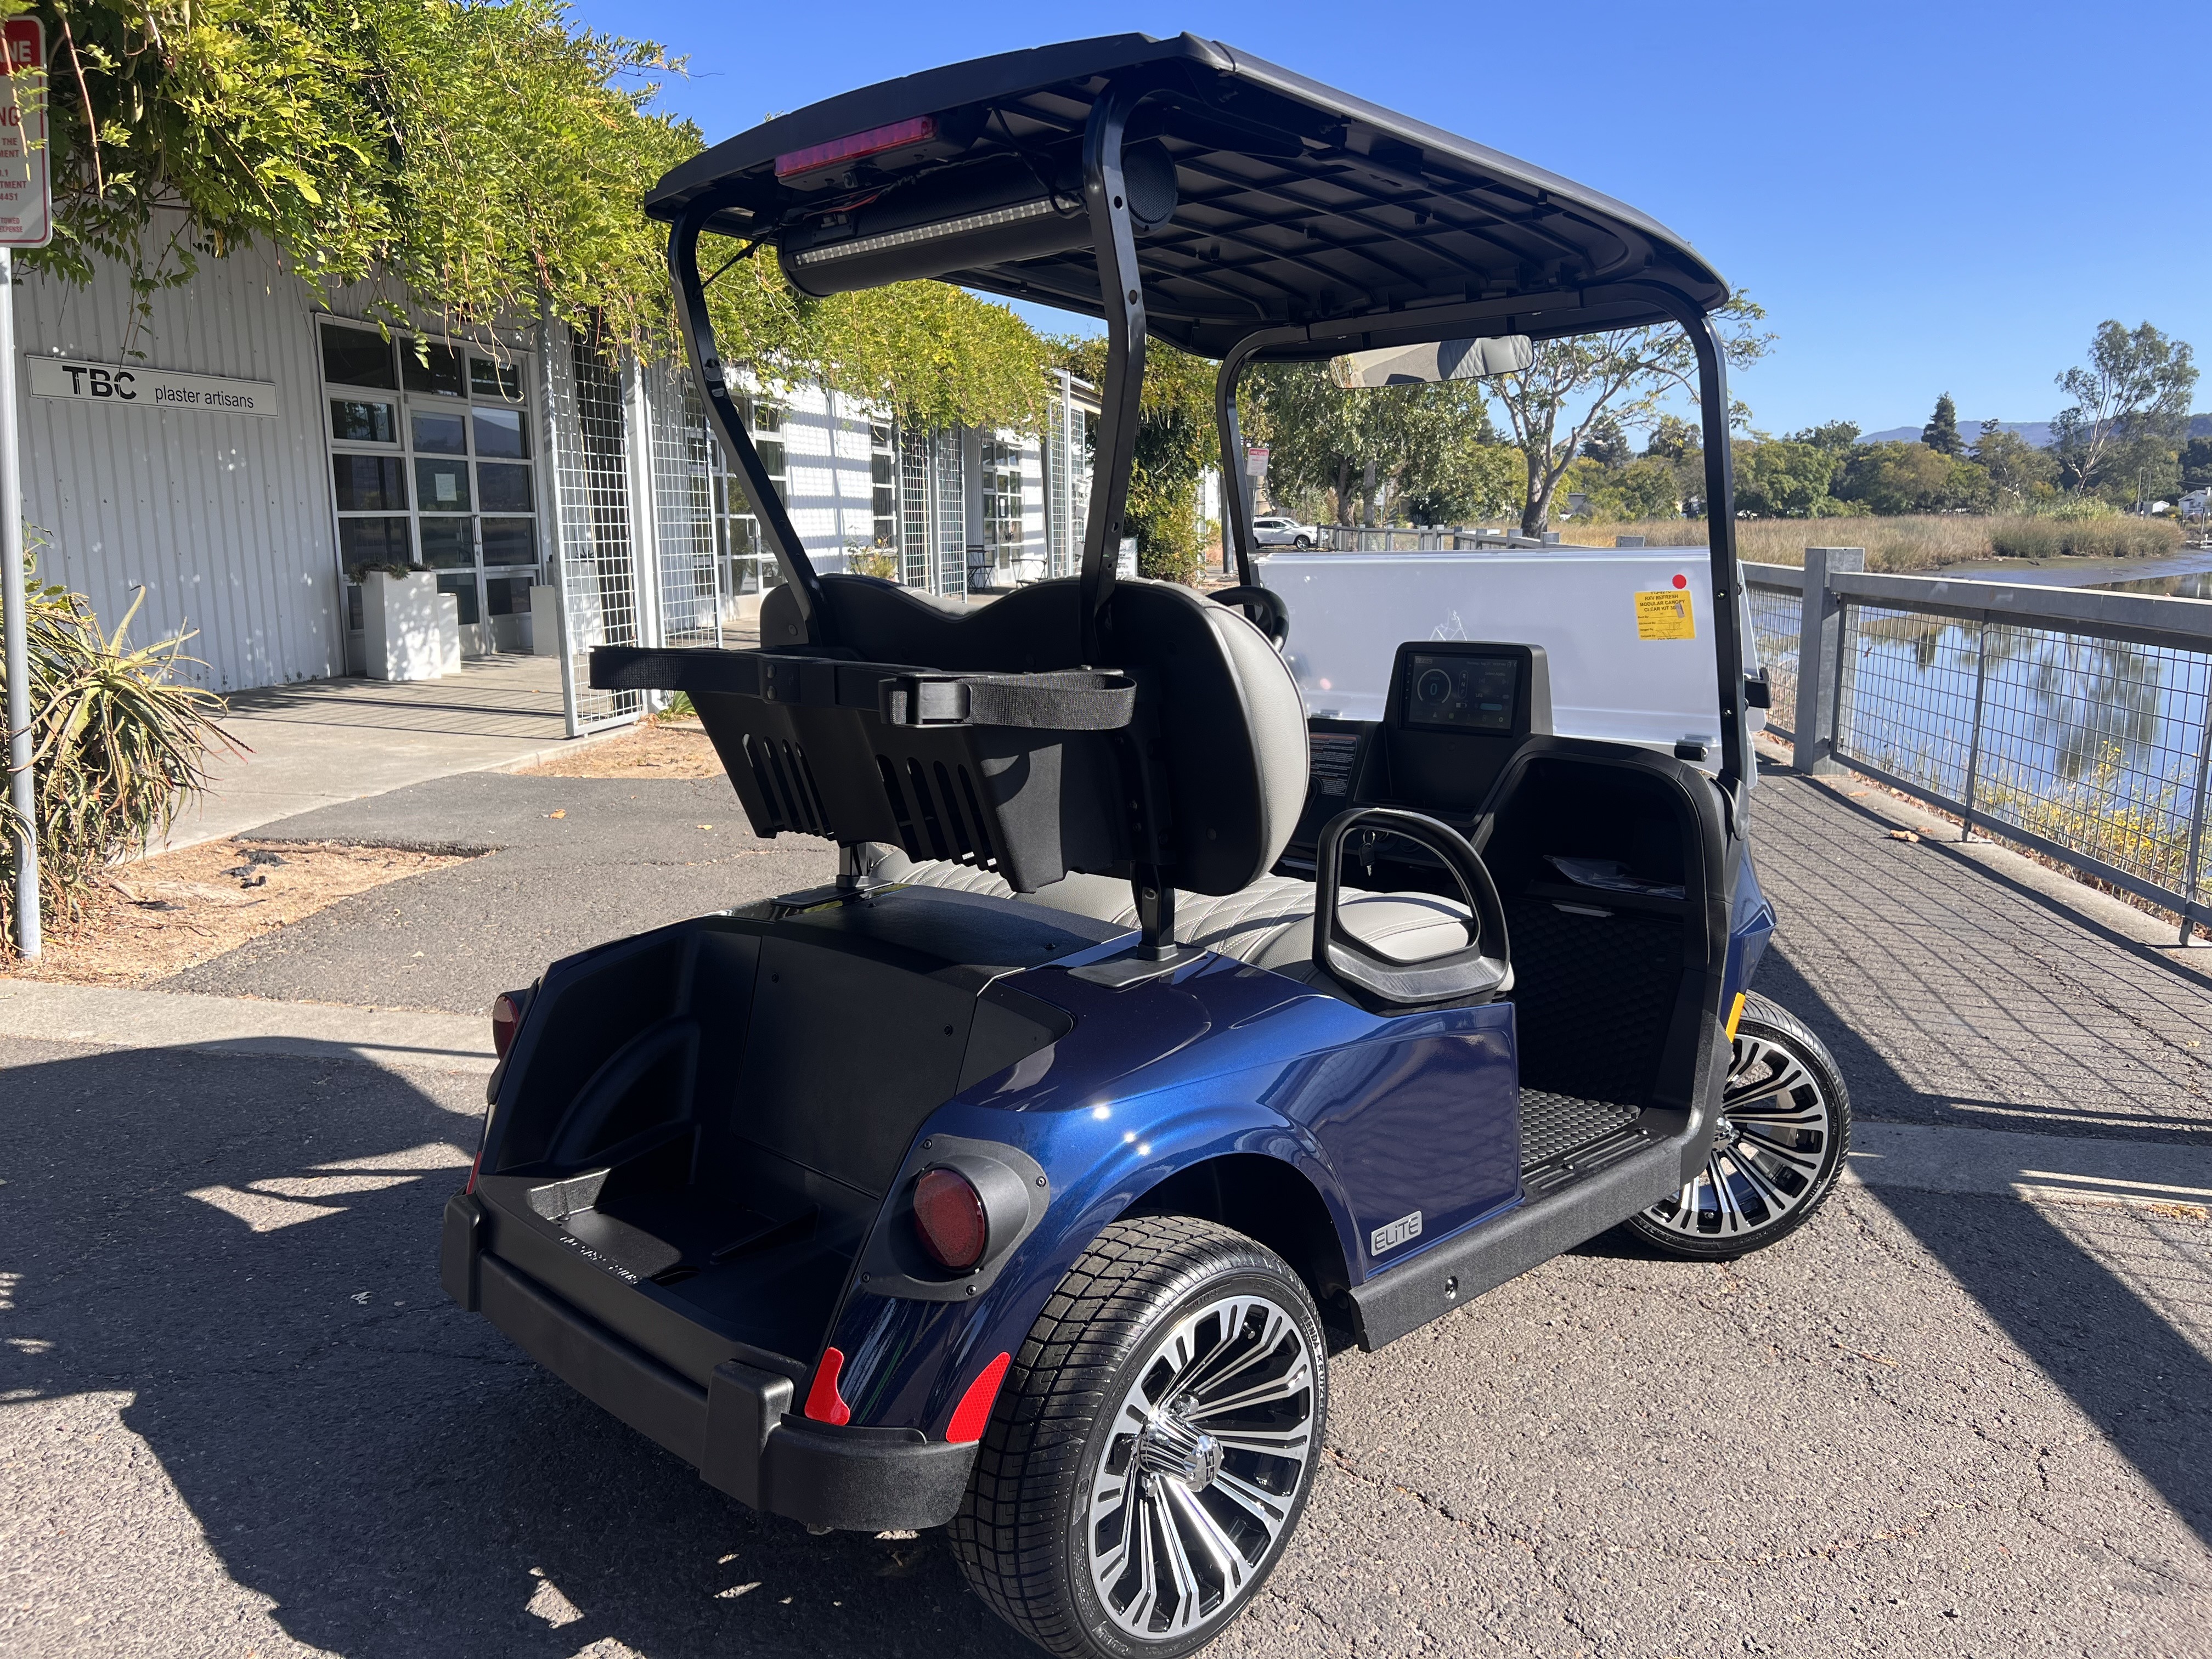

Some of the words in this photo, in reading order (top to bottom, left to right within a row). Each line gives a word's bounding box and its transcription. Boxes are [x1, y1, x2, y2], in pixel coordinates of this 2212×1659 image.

[62, 365, 137, 399] TBC
[155, 385, 201, 403] plaster
[205, 391, 254, 408] artisans
